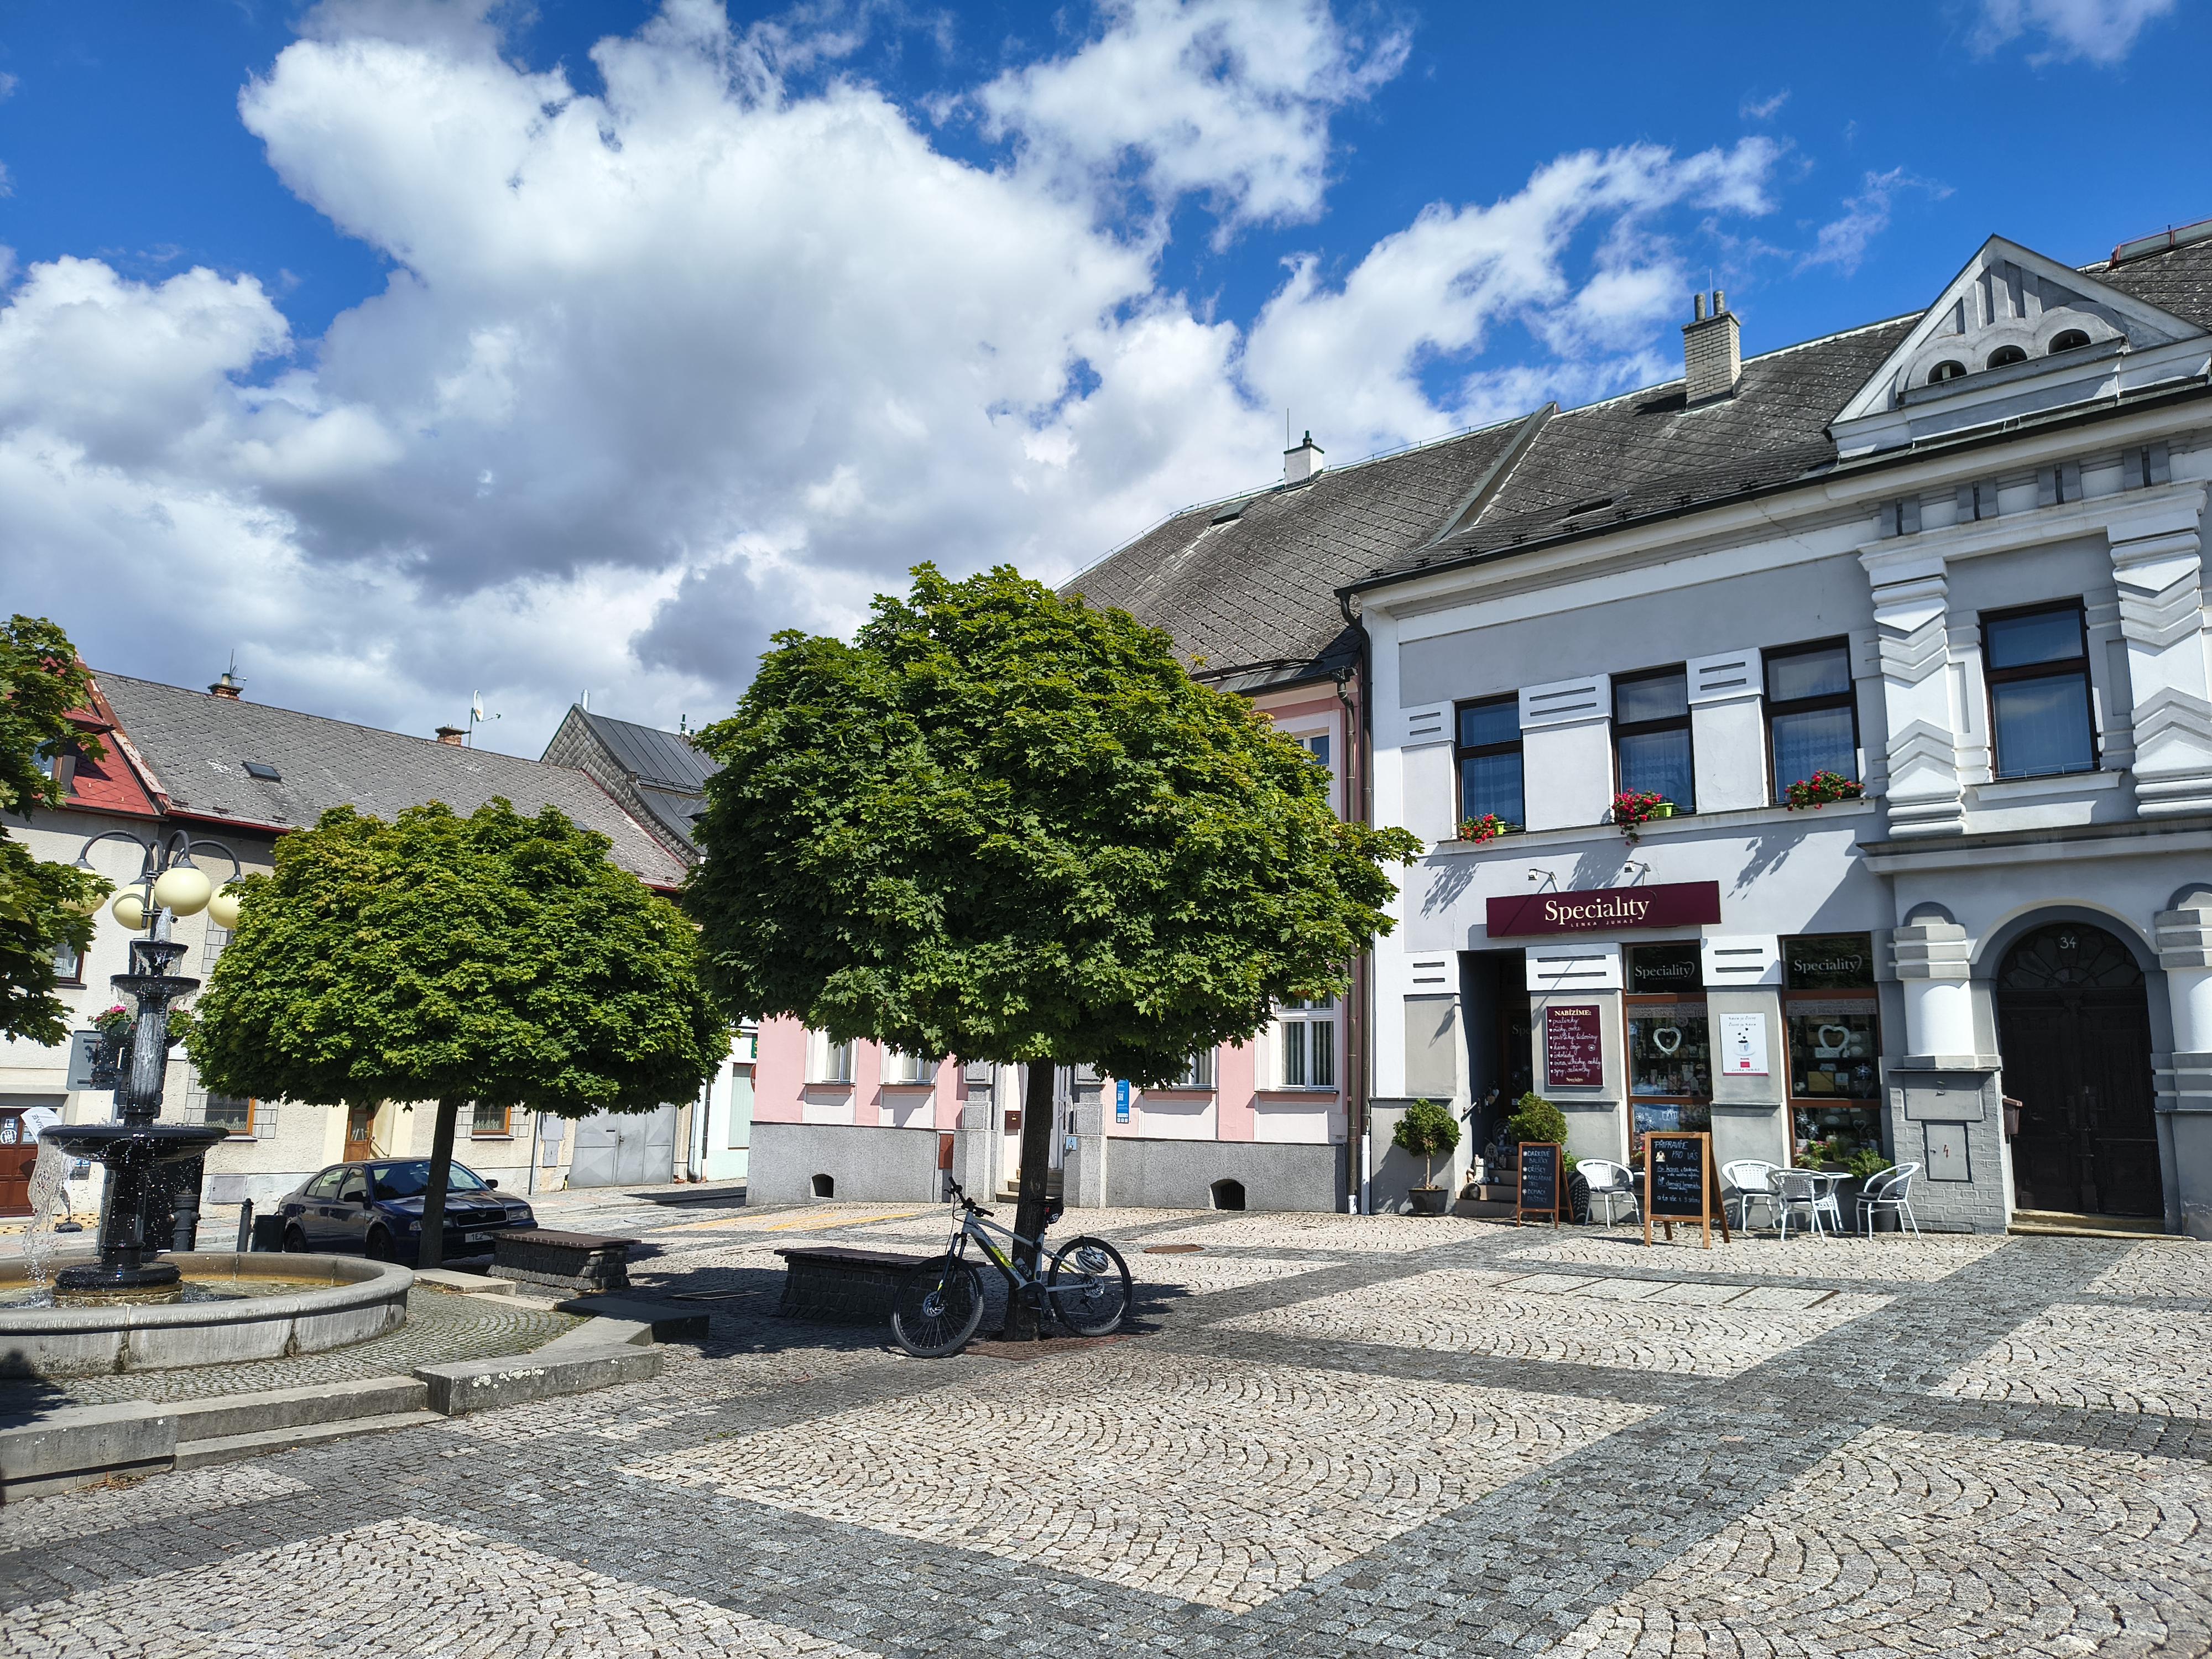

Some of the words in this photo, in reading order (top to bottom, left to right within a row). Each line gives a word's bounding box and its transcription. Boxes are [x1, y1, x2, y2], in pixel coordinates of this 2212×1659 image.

[1545, 896, 1650, 925] Speciality
[2060, 936, 2077, 949] 34
[1635, 964, 1691, 979] Speciality
[1794, 958, 1858, 974] Speciality
[1672, 1151, 1683, 1159] PRO
